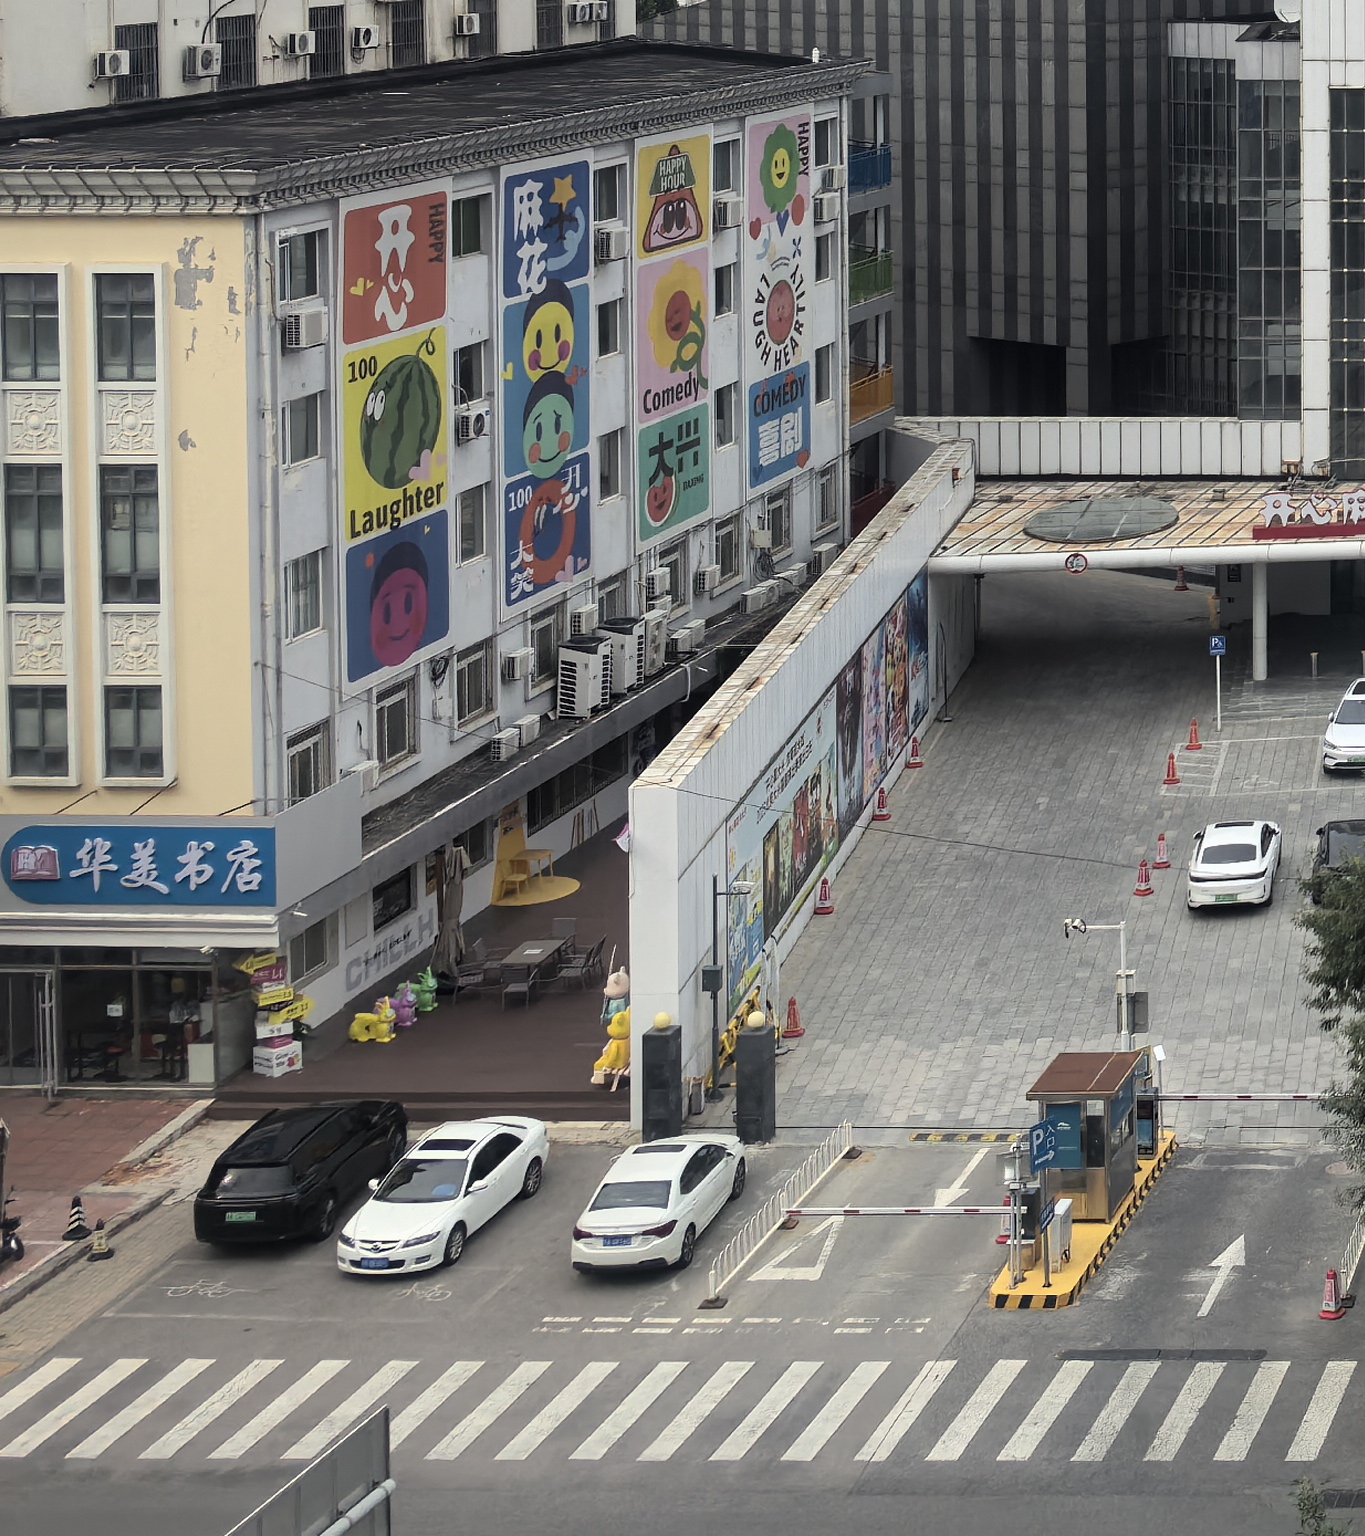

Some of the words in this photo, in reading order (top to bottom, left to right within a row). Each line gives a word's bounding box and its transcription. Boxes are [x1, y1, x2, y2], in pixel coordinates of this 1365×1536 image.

[660, 155, 687, 177] HAPPY
[798, 121, 809, 177] HAPPY
[660, 172, 686, 192] HOUR
[428, 203, 445, 264] HAPPY
[514, 179, 548, 295] 麻花
[374, 204, 415, 332] 开心
[348, 355, 378, 384] 100
[643, 371, 700, 414] Comedy
[754, 373, 807, 418] COMEDY
[648, 417, 701, 488] 大兴
[350, 481, 445, 540] Laughter
[508, 485, 533, 513] 100
[69, 837, 263, 894] 华美书店
[1032, 1128, 1045, 1156] P
[1045, 1124, 1056, 1150] 入口
